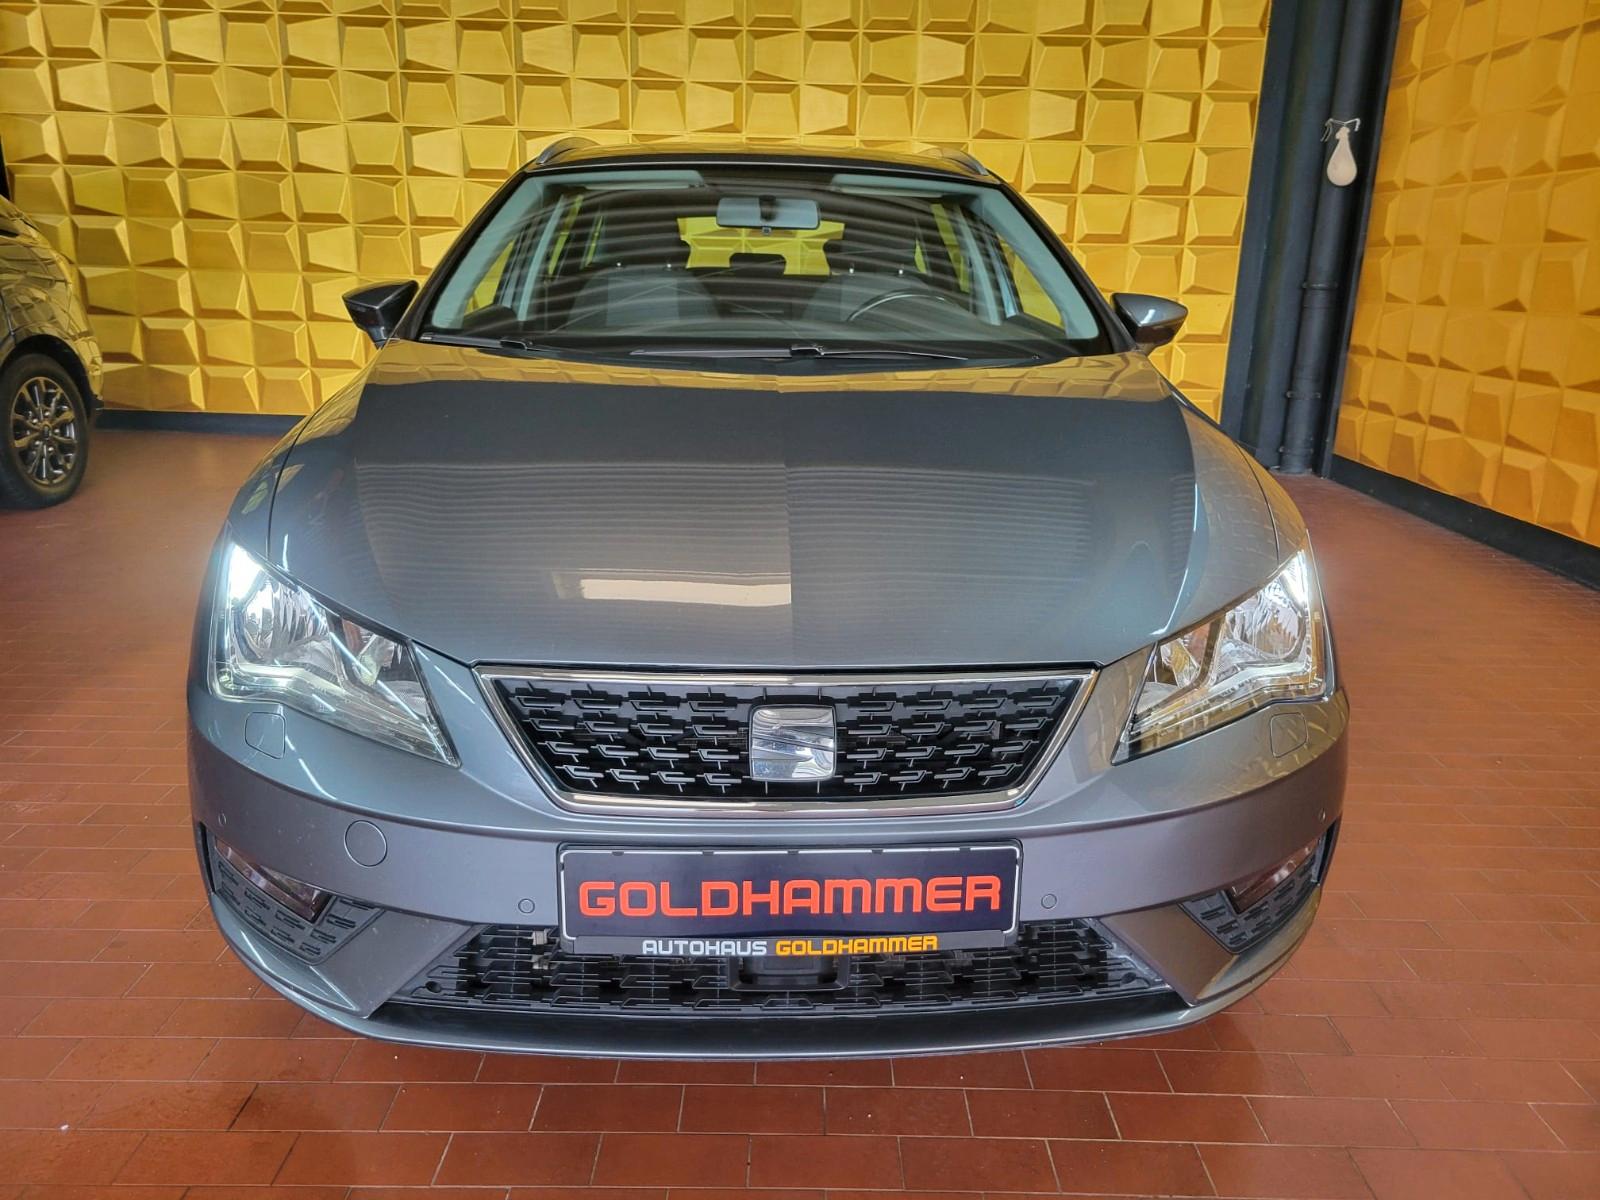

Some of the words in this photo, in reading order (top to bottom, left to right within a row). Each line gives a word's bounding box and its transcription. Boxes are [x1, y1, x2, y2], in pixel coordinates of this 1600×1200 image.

[579, 875, 1001, 916] GOLDHAMMER
[642, 939, 767, 956] AUTOHAUS
[775, 935, 938, 956] GOLDHAMMER
